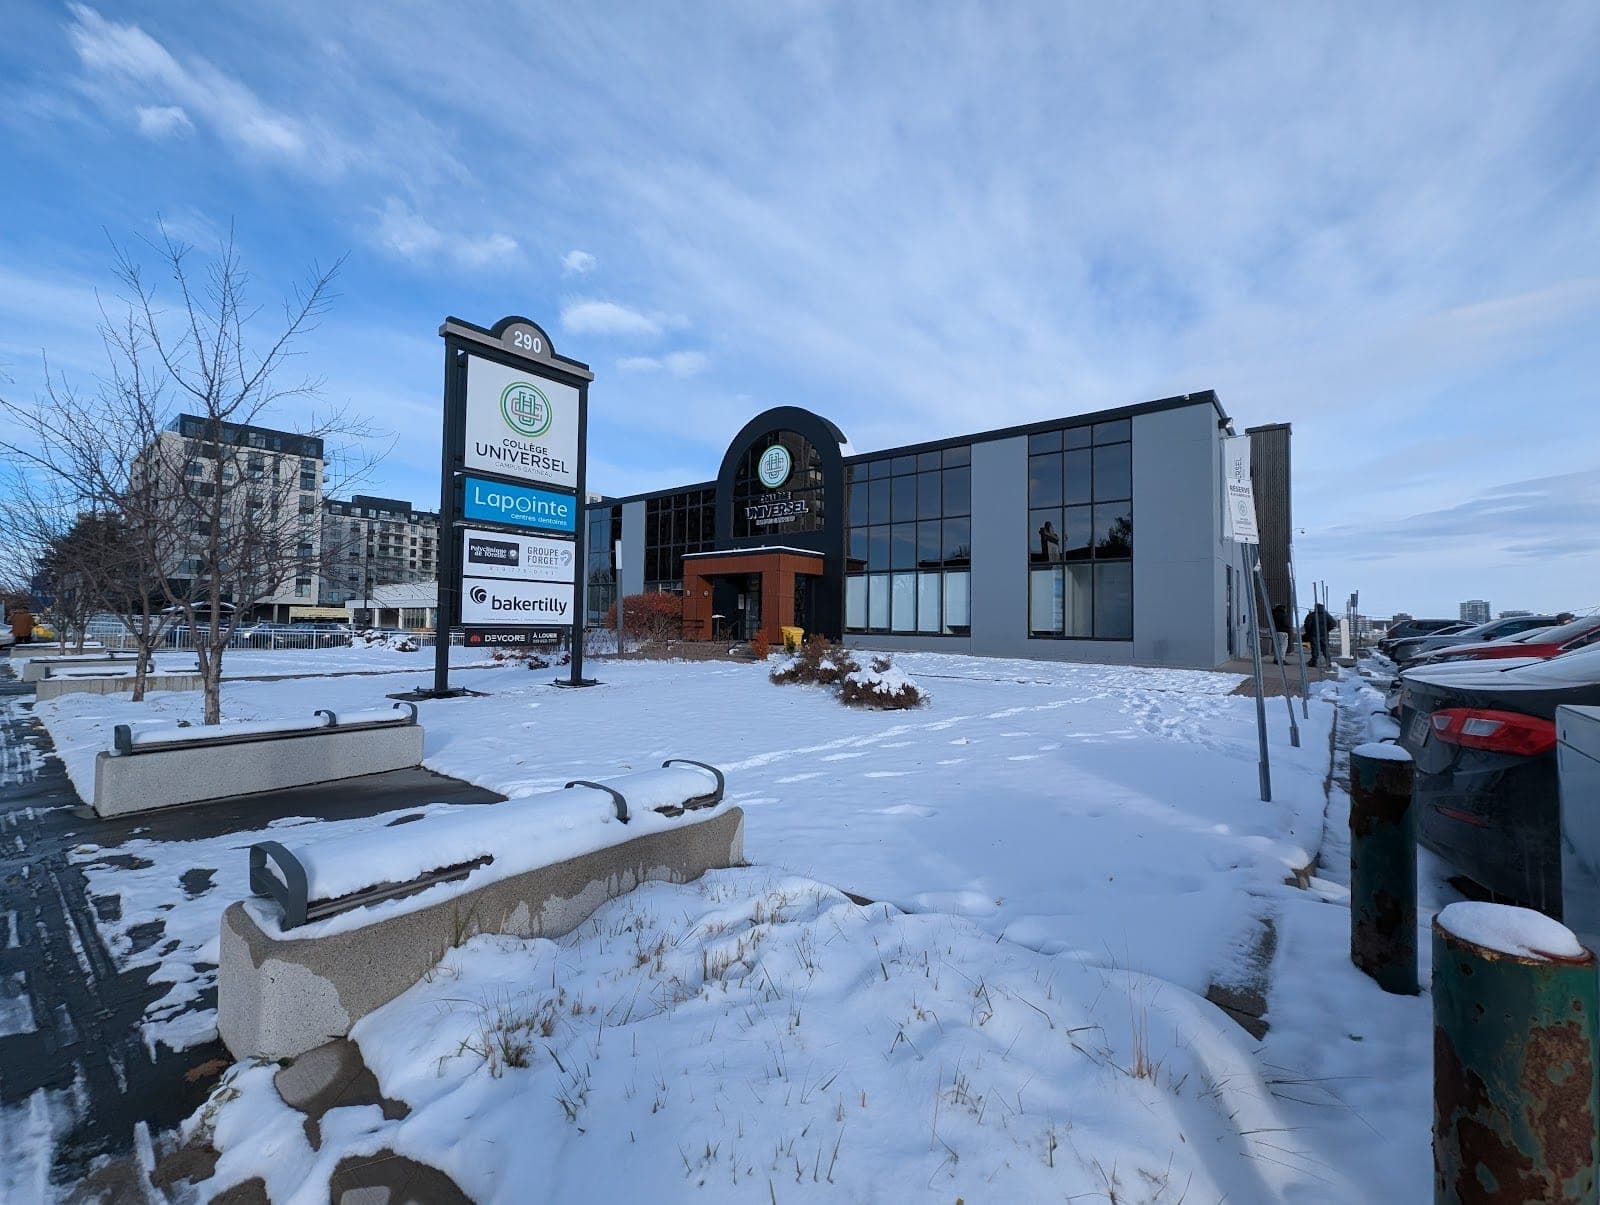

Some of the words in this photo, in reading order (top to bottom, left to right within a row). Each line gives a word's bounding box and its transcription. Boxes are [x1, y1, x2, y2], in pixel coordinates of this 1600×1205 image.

[514, 330, 542, 354] 290
[502, 438, 548, 456] COLLÈGE
[475, 442, 569, 474] UNIVERSEL
[494, 461, 522, 472] CAMPUS
[523, 465, 553, 478] GATINEAU
[475, 486, 568, 517] Lapointe
[510, 513, 536, 522] centres
[538, 517, 567, 526] dentaires
[527, 546, 559, 557] GROUPE
[527, 555, 559, 566] FORGET
[491, 595, 567, 616] bakertilly
[484, 634, 526, 642] DEVCORE
